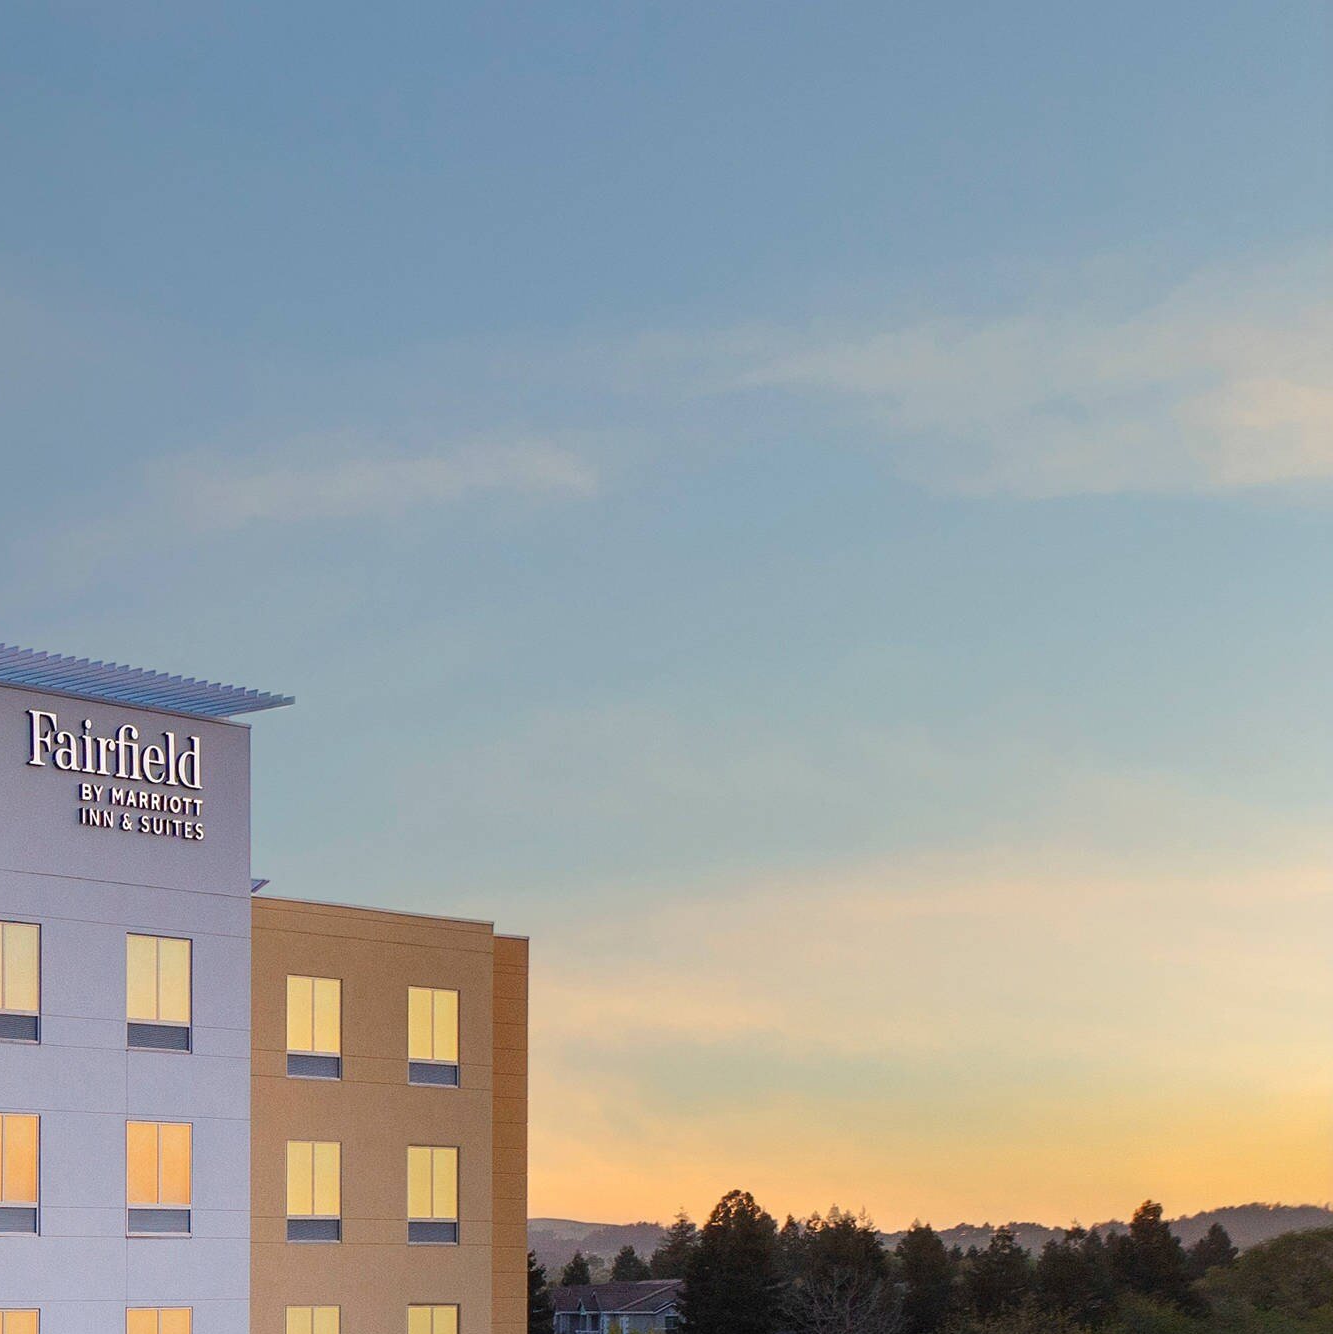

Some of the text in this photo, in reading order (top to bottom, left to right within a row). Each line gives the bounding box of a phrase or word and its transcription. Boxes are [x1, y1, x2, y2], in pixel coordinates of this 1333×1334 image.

[28, 709, 203, 790] Fairfield
[81, 783, 204, 817] BY MARRIOTT
[81, 807, 205, 841] INN & SUITES
